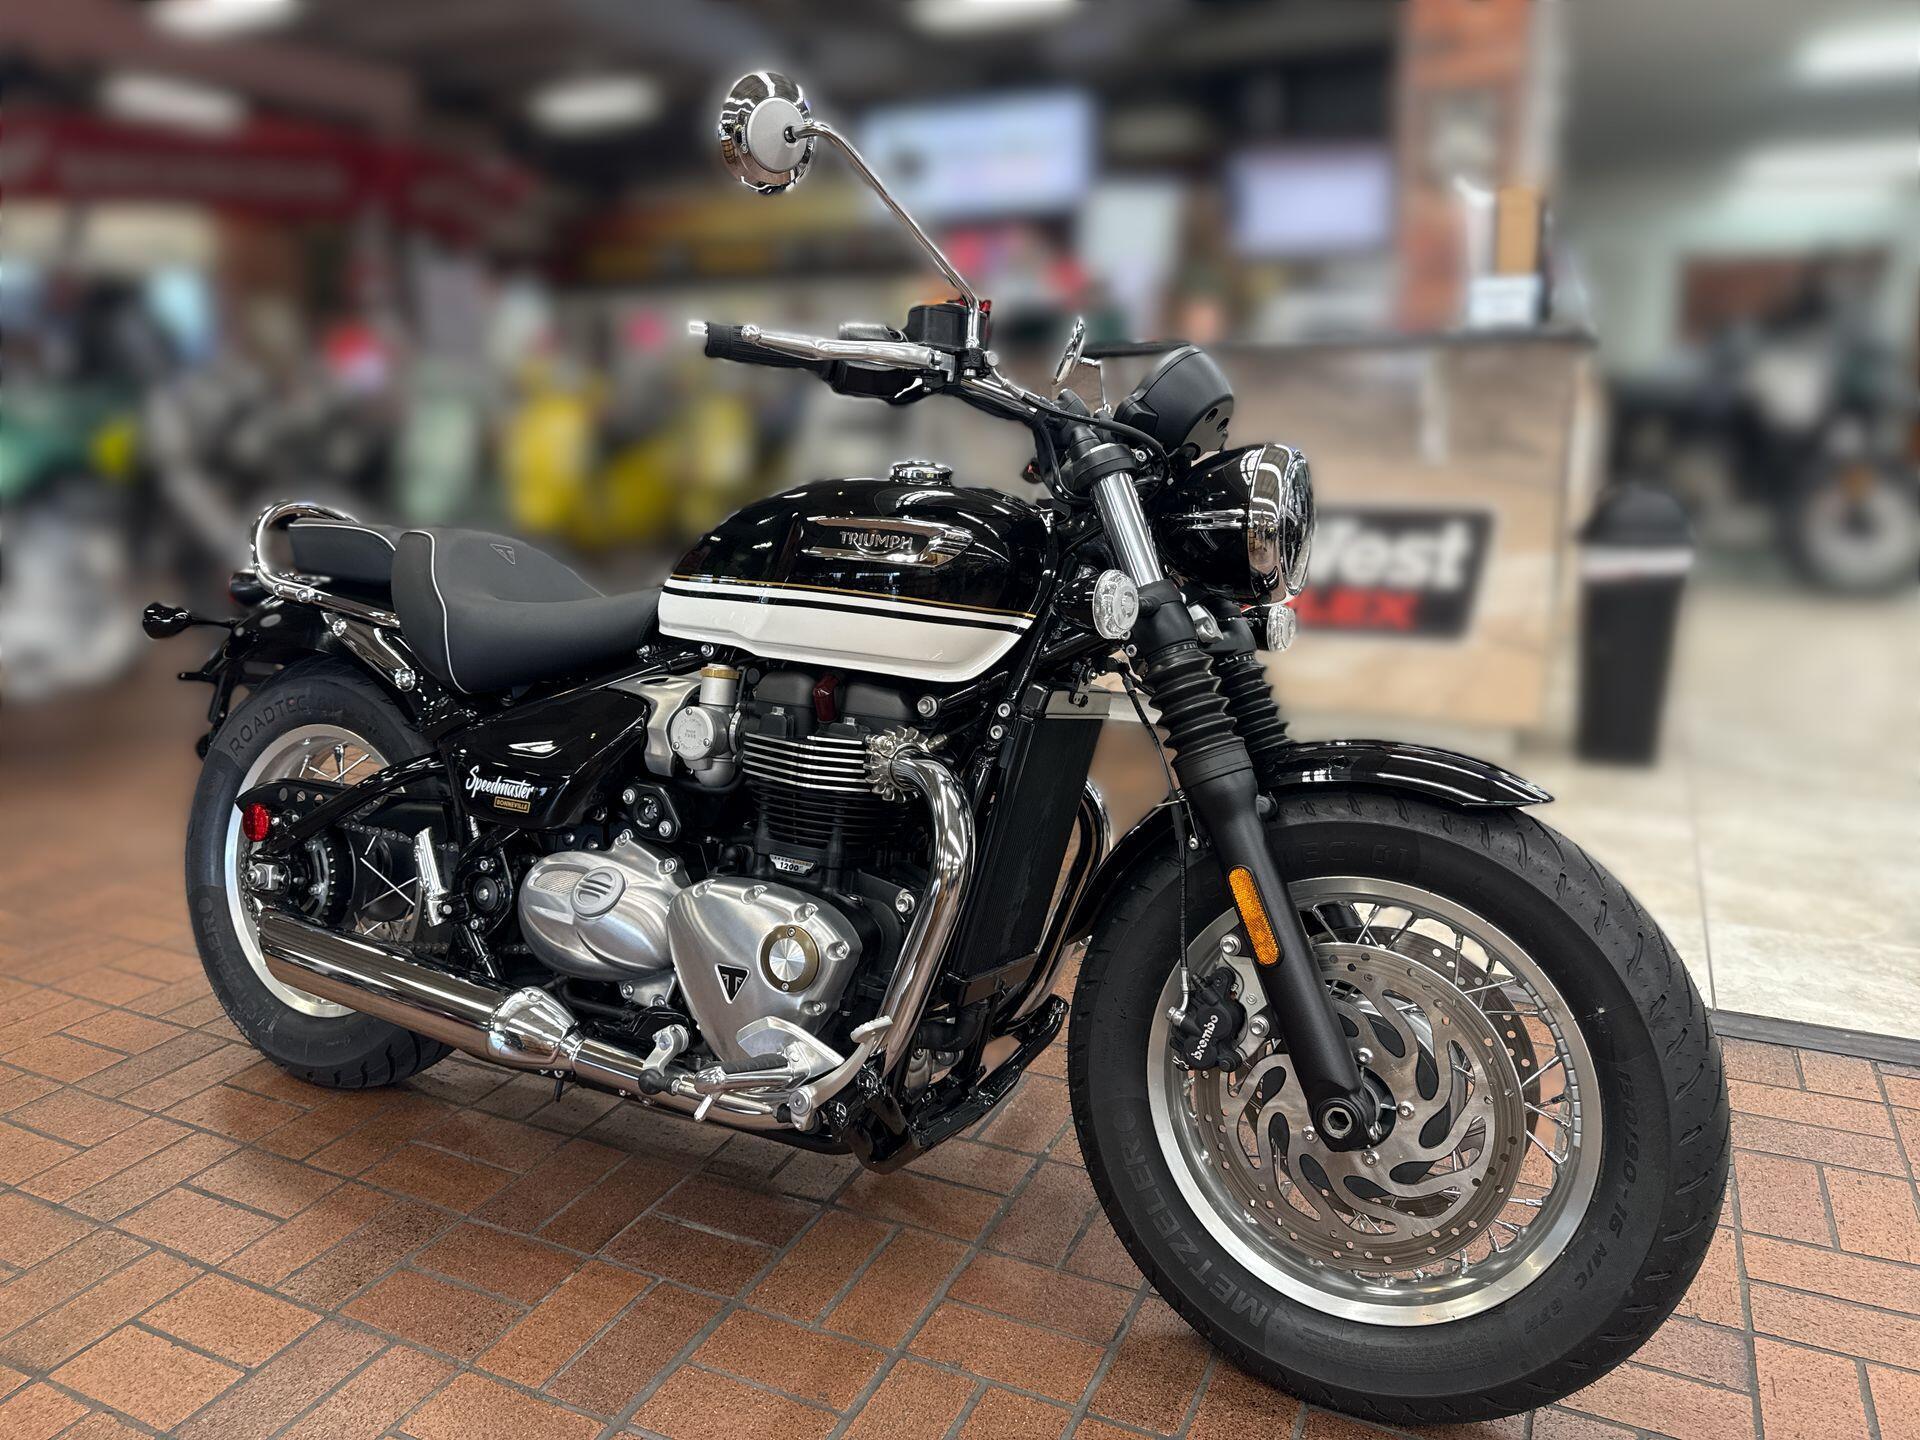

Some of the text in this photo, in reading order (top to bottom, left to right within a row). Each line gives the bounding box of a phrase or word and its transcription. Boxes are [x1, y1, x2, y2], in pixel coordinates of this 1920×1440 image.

[840, 531, 913, 552] TRIUMPH
[1288, 584, 1418, 632] LEX
[229, 695, 306, 757] ROADTEC
[466, 765, 535, 799] Speedmaster
[496, 799, 528, 810] BONNEVILLE
[780, 861, 800, 871] 1200
[1191, 1015, 1218, 1060] brembo
[1120, 1130, 1268, 1328] METZELER
